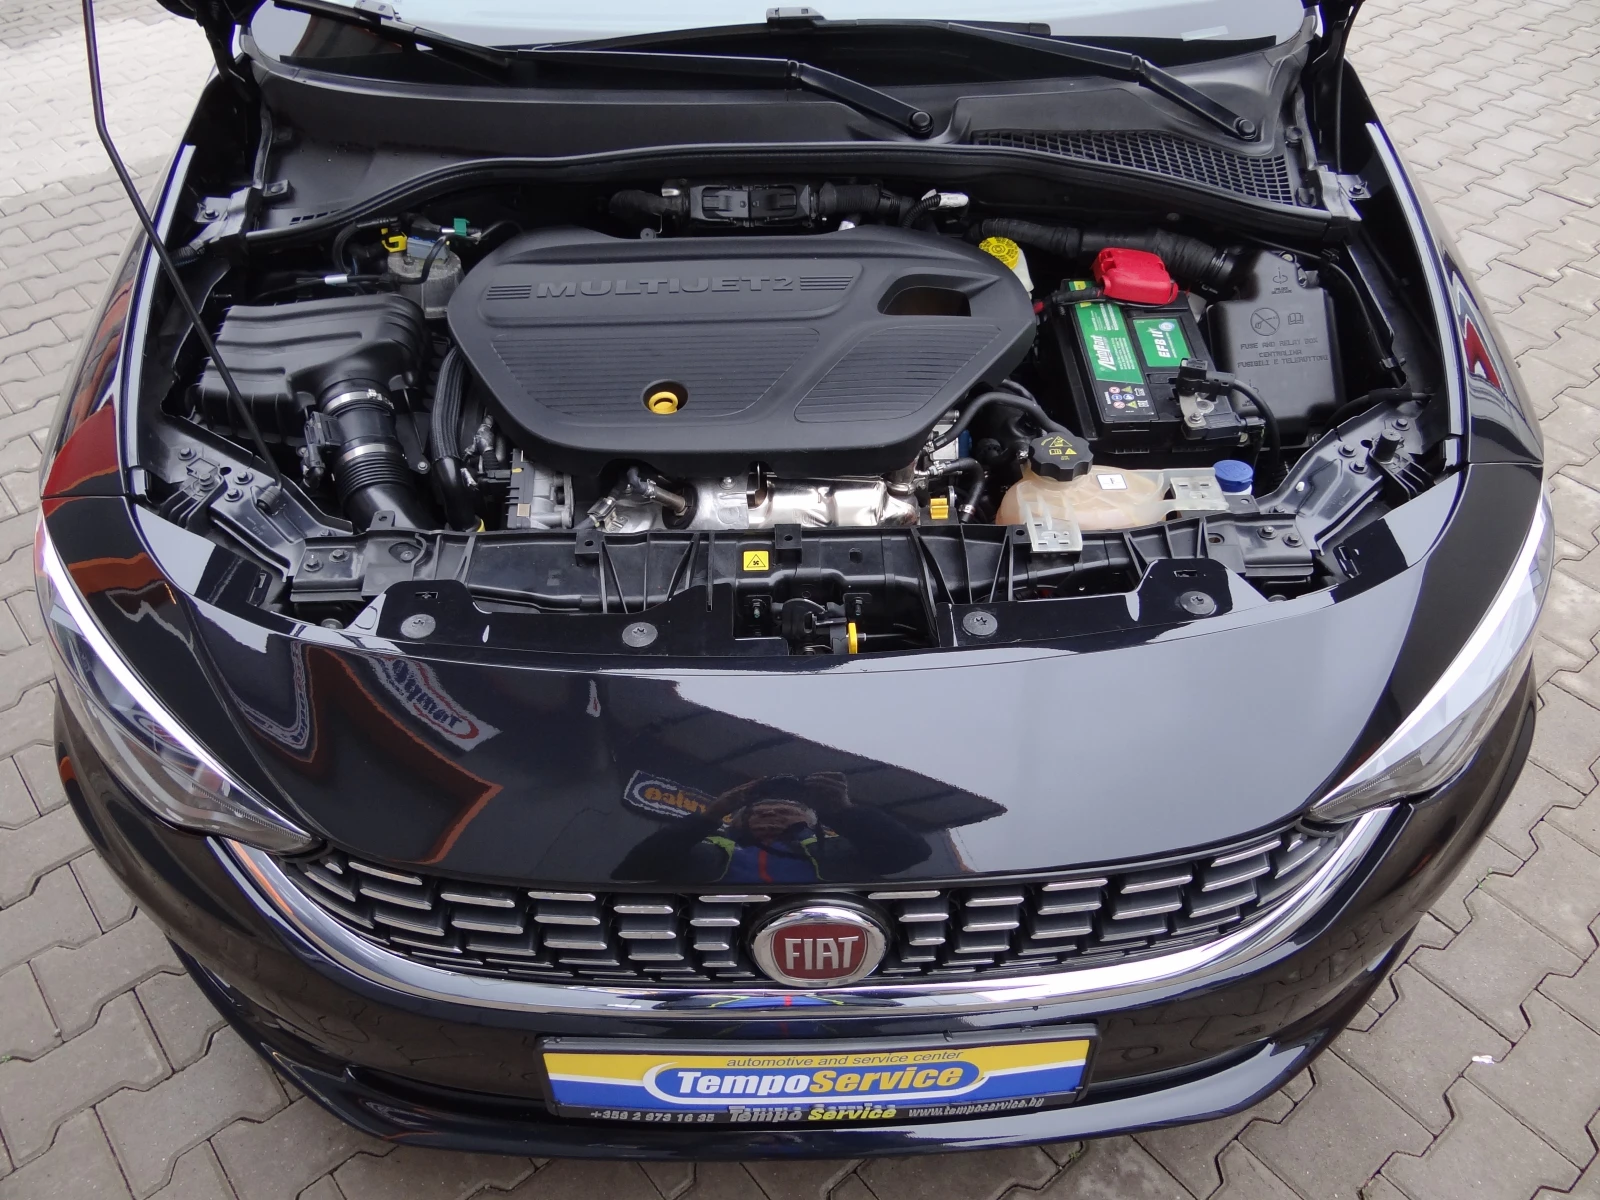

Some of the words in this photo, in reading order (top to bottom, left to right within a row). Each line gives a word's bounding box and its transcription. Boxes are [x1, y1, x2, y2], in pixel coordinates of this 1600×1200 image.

[1154, 338, 1171, 358] EFB
[1240, 342, 1259, 350] FUSE
[1262, 341, 1276, 349] AND
[1279, 339, 1301, 347] RELAY
[1304, 337, 1319, 345] BOX
[784, 935, 860, 971] FIAT
[726, 1056, 814, 1067] automotive
[818, 1055, 849, 1066] and
[852, 1053, 907, 1065] service
[913, 1051, 964, 1063] center
[677, 1066, 964, 1096] TempoService
[631, 1111, 642, 1121] 2
[729, 1107, 802, 1123] Tempo
[808, 1105, 897, 1121] Service
[908, 1097, 1045, 1117] www.temposervice.bg
